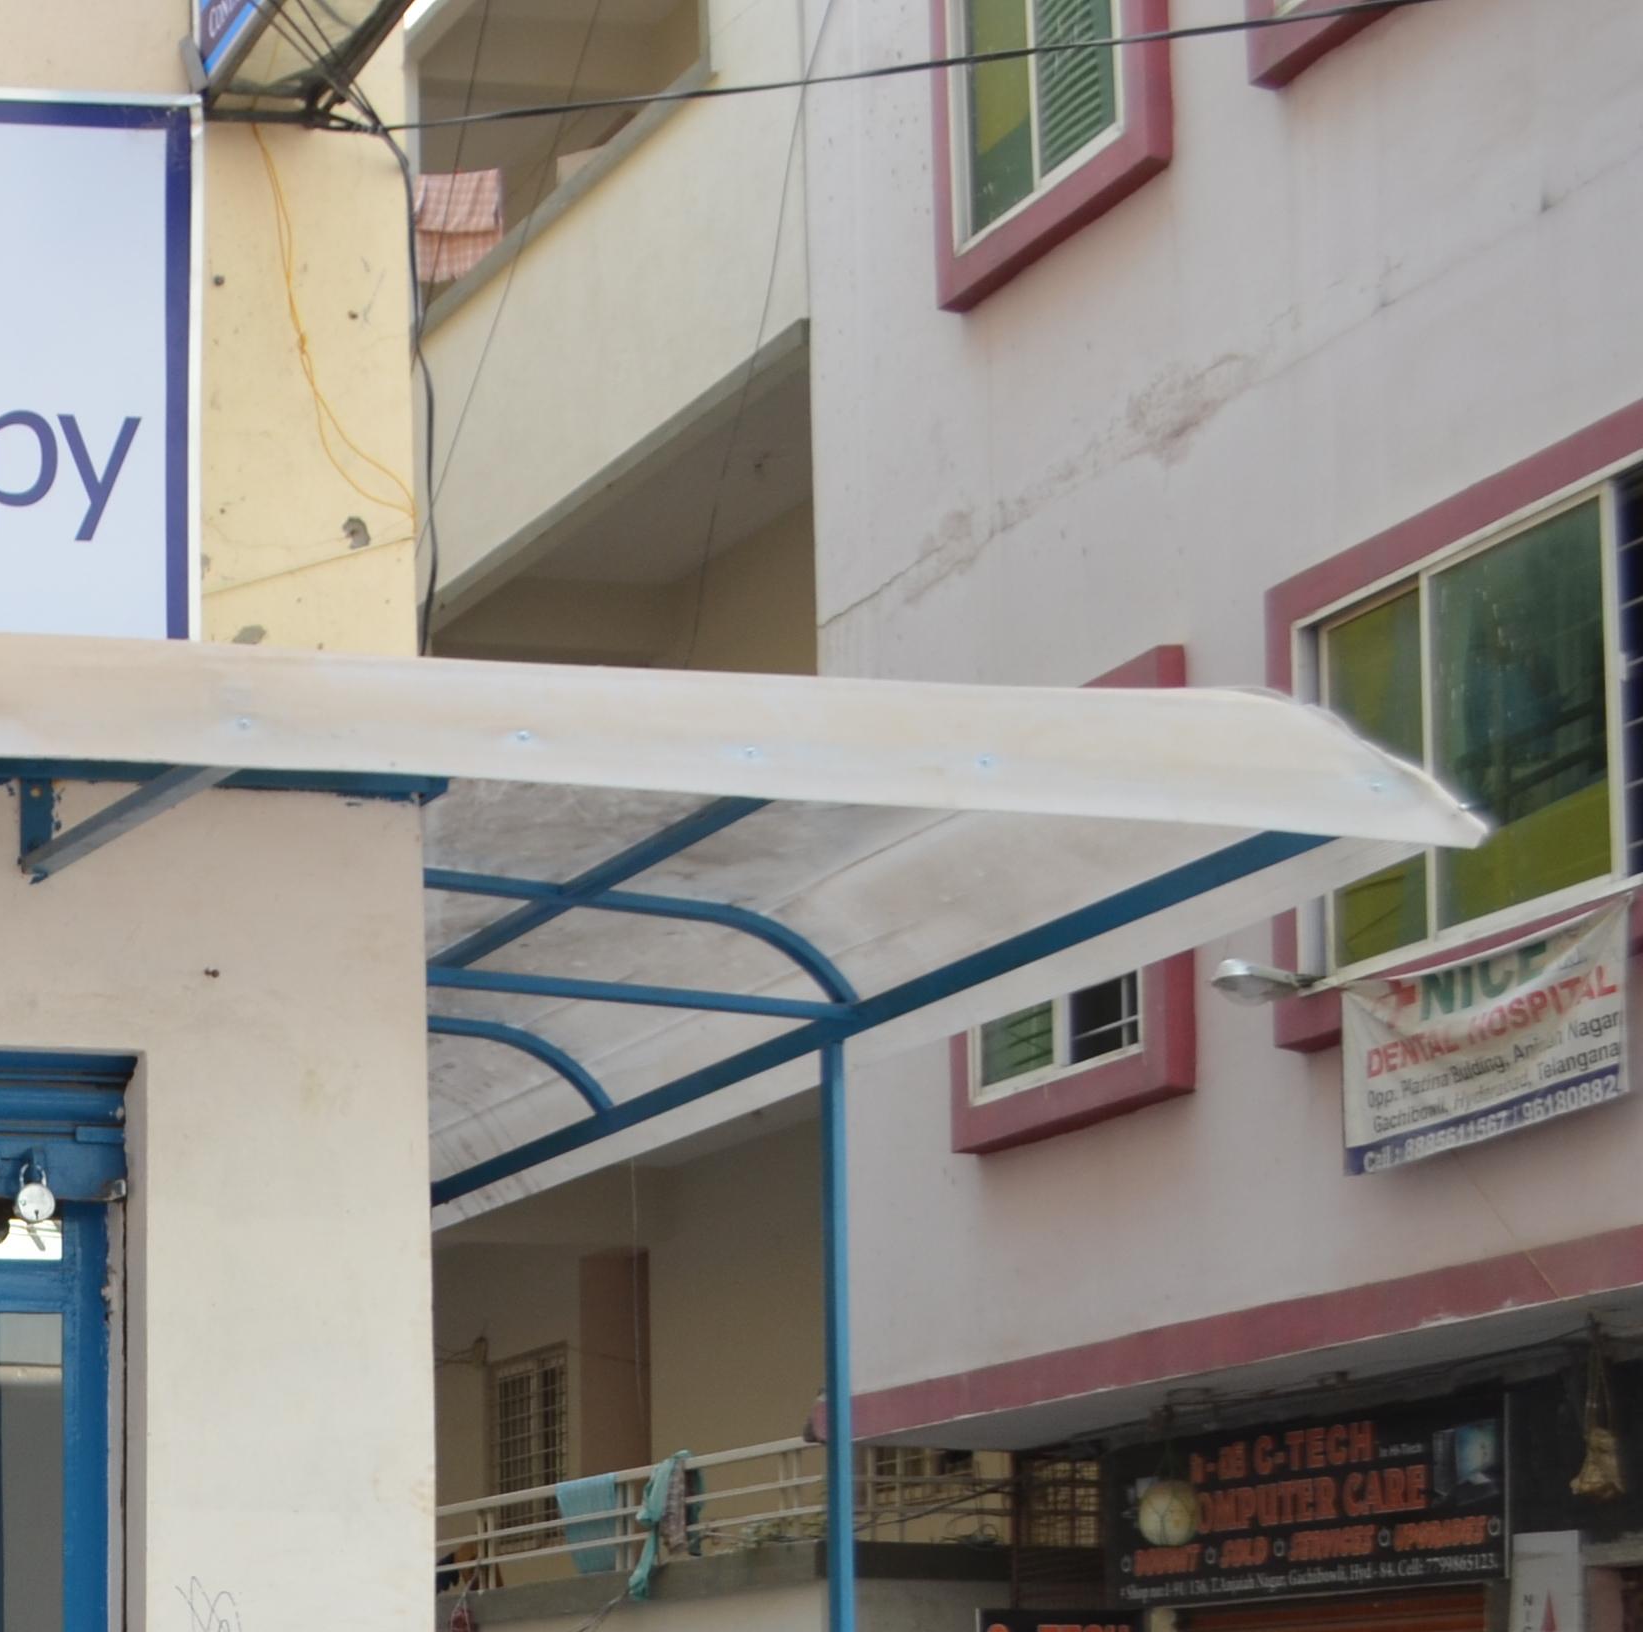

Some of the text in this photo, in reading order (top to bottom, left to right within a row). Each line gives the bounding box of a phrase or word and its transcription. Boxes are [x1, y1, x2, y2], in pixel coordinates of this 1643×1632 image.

[1367, 965, 1618, 1079] DENTAL HOSPITAL
[1568, 1009, 1621, 1040] Nagar
[1537, 1041, 1621, 1080] Telangana
[1197, 1464, 1428, 1535] OMPUTER CARE
